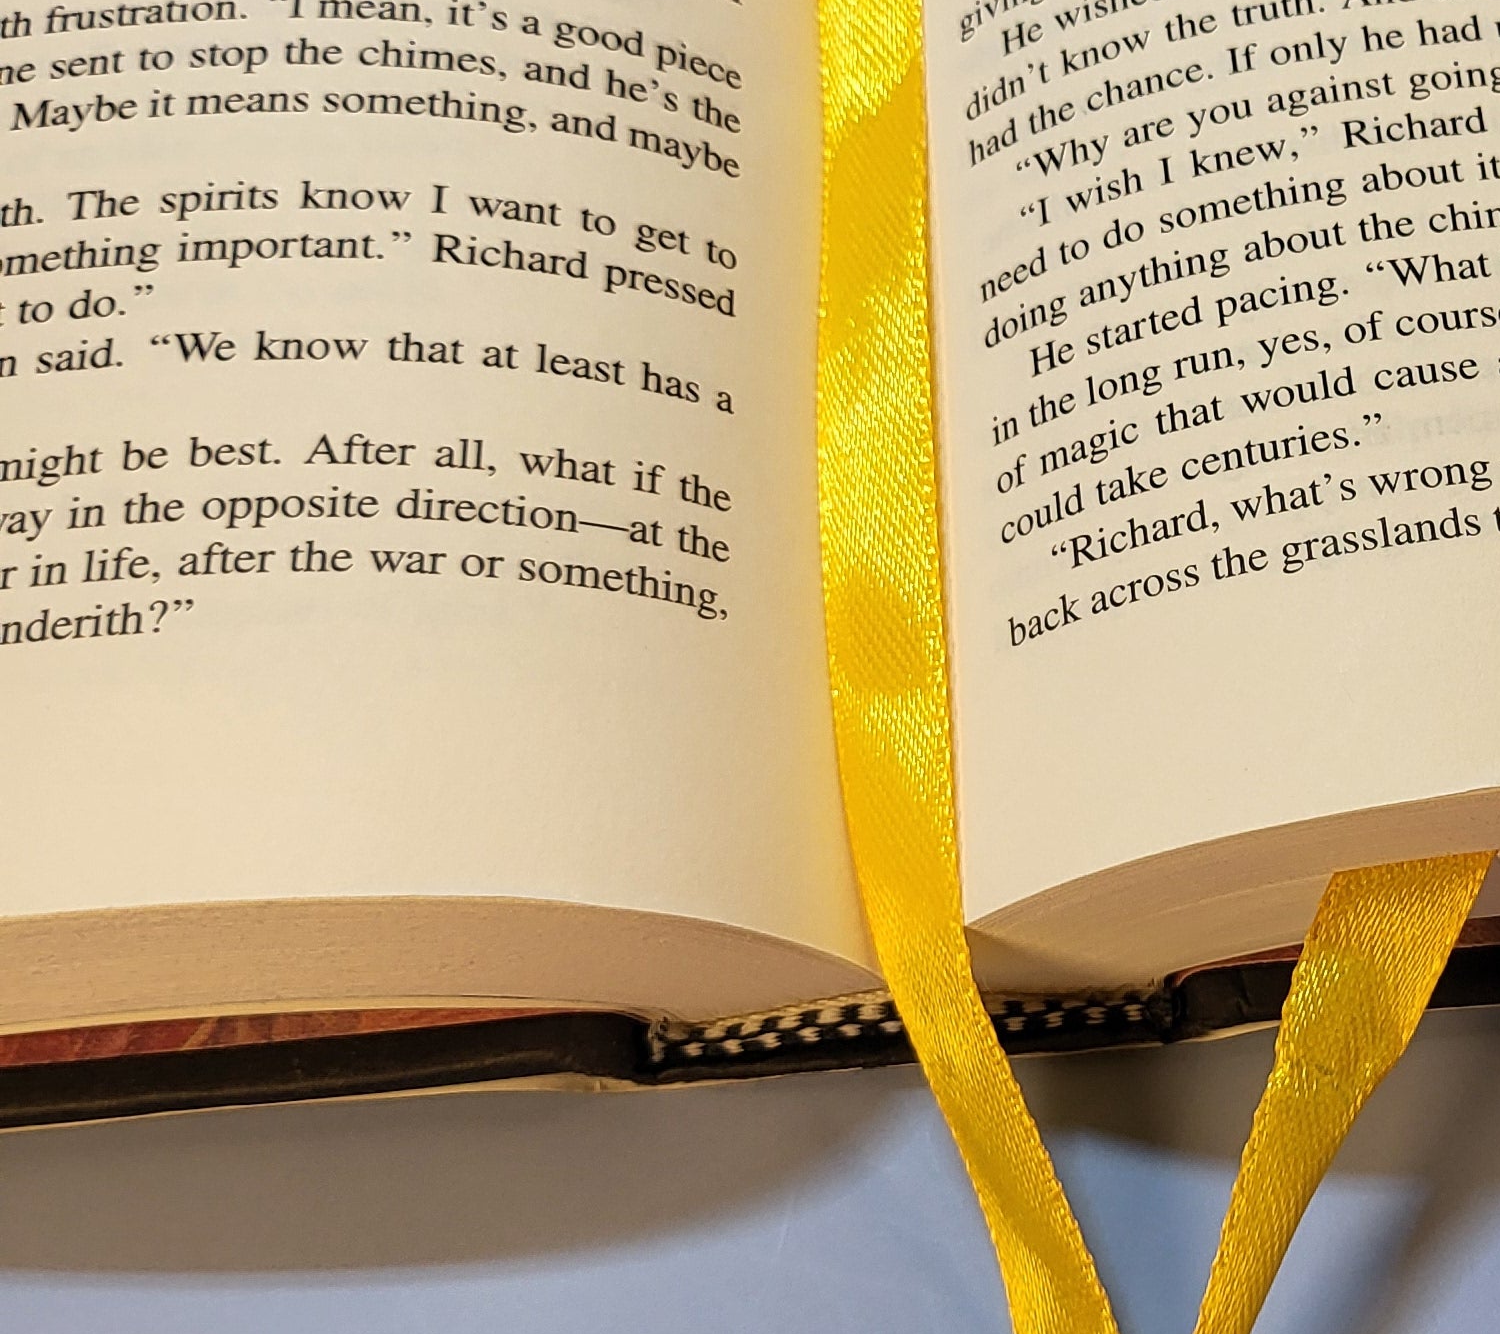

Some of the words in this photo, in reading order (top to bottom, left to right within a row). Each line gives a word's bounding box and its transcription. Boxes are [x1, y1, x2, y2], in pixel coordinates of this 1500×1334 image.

[1019, 195, 1052, 228] “I
[1064, 167, 1145, 214] wish
[1157, 155, 1176, 187] I
[1188, 124, 1319, 179] knew,”
[1340, 104, 1489, 150] Richard
[65, 188, 141, 221] The
[157, 180, 279, 222] spirits
[298, 179, 413, 212] know
[430, 183, 450, 215] I
[467, 194, 563, 228] want
[579, 207, 617, 237] to
[633, 222, 691, 256] get
[704, 239, 738, 270] to
[33, 337, 124, 375] said.
[149, 331, 237, 364] “We
[252, 329, 370, 361] know
[386, 331, 465, 366] that
[480, 344, 520, 370] at
[534, 342, 626, 386] least
[639, 360, 701, 404] has
[715, 390, 735, 415] a
[121, 439, 169, 472] be
[188, 436, 282, 468] best.
[302, 432, 417, 467] After
[433, 438, 497, 477] all,
[518, 447, 617, 487] what
[631, 460, 667, 496] if
[678, 473, 732, 513] the
[996, 453, 1028, 495] of
[1039, 418, 1140, 477] magic
[1154, 395, 1226, 436] that
[1239, 365, 1358, 415] would
[1373, 358, 1481, 391] cause
[1051, 498, 1220, 570] “Richard,
[1229, 472, 1357, 522] what’s
[1367, 460, 1493, 496] wrong
[28, 553, 69, 588] in
[80, 546, 161, 585] life,
[177, 541, 277, 577] after
[289, 539, 354, 573] the
[368, 549, 448, 576] war
[459, 553, 506, 579] or
[517, 558, 728, 621] something,
[1007, 593, 1083, 647] back
[1090, 563, 1201, 615] across
[1209, 545, 1269, 581] the
[1281, 506, 1482, 575] grasslands
